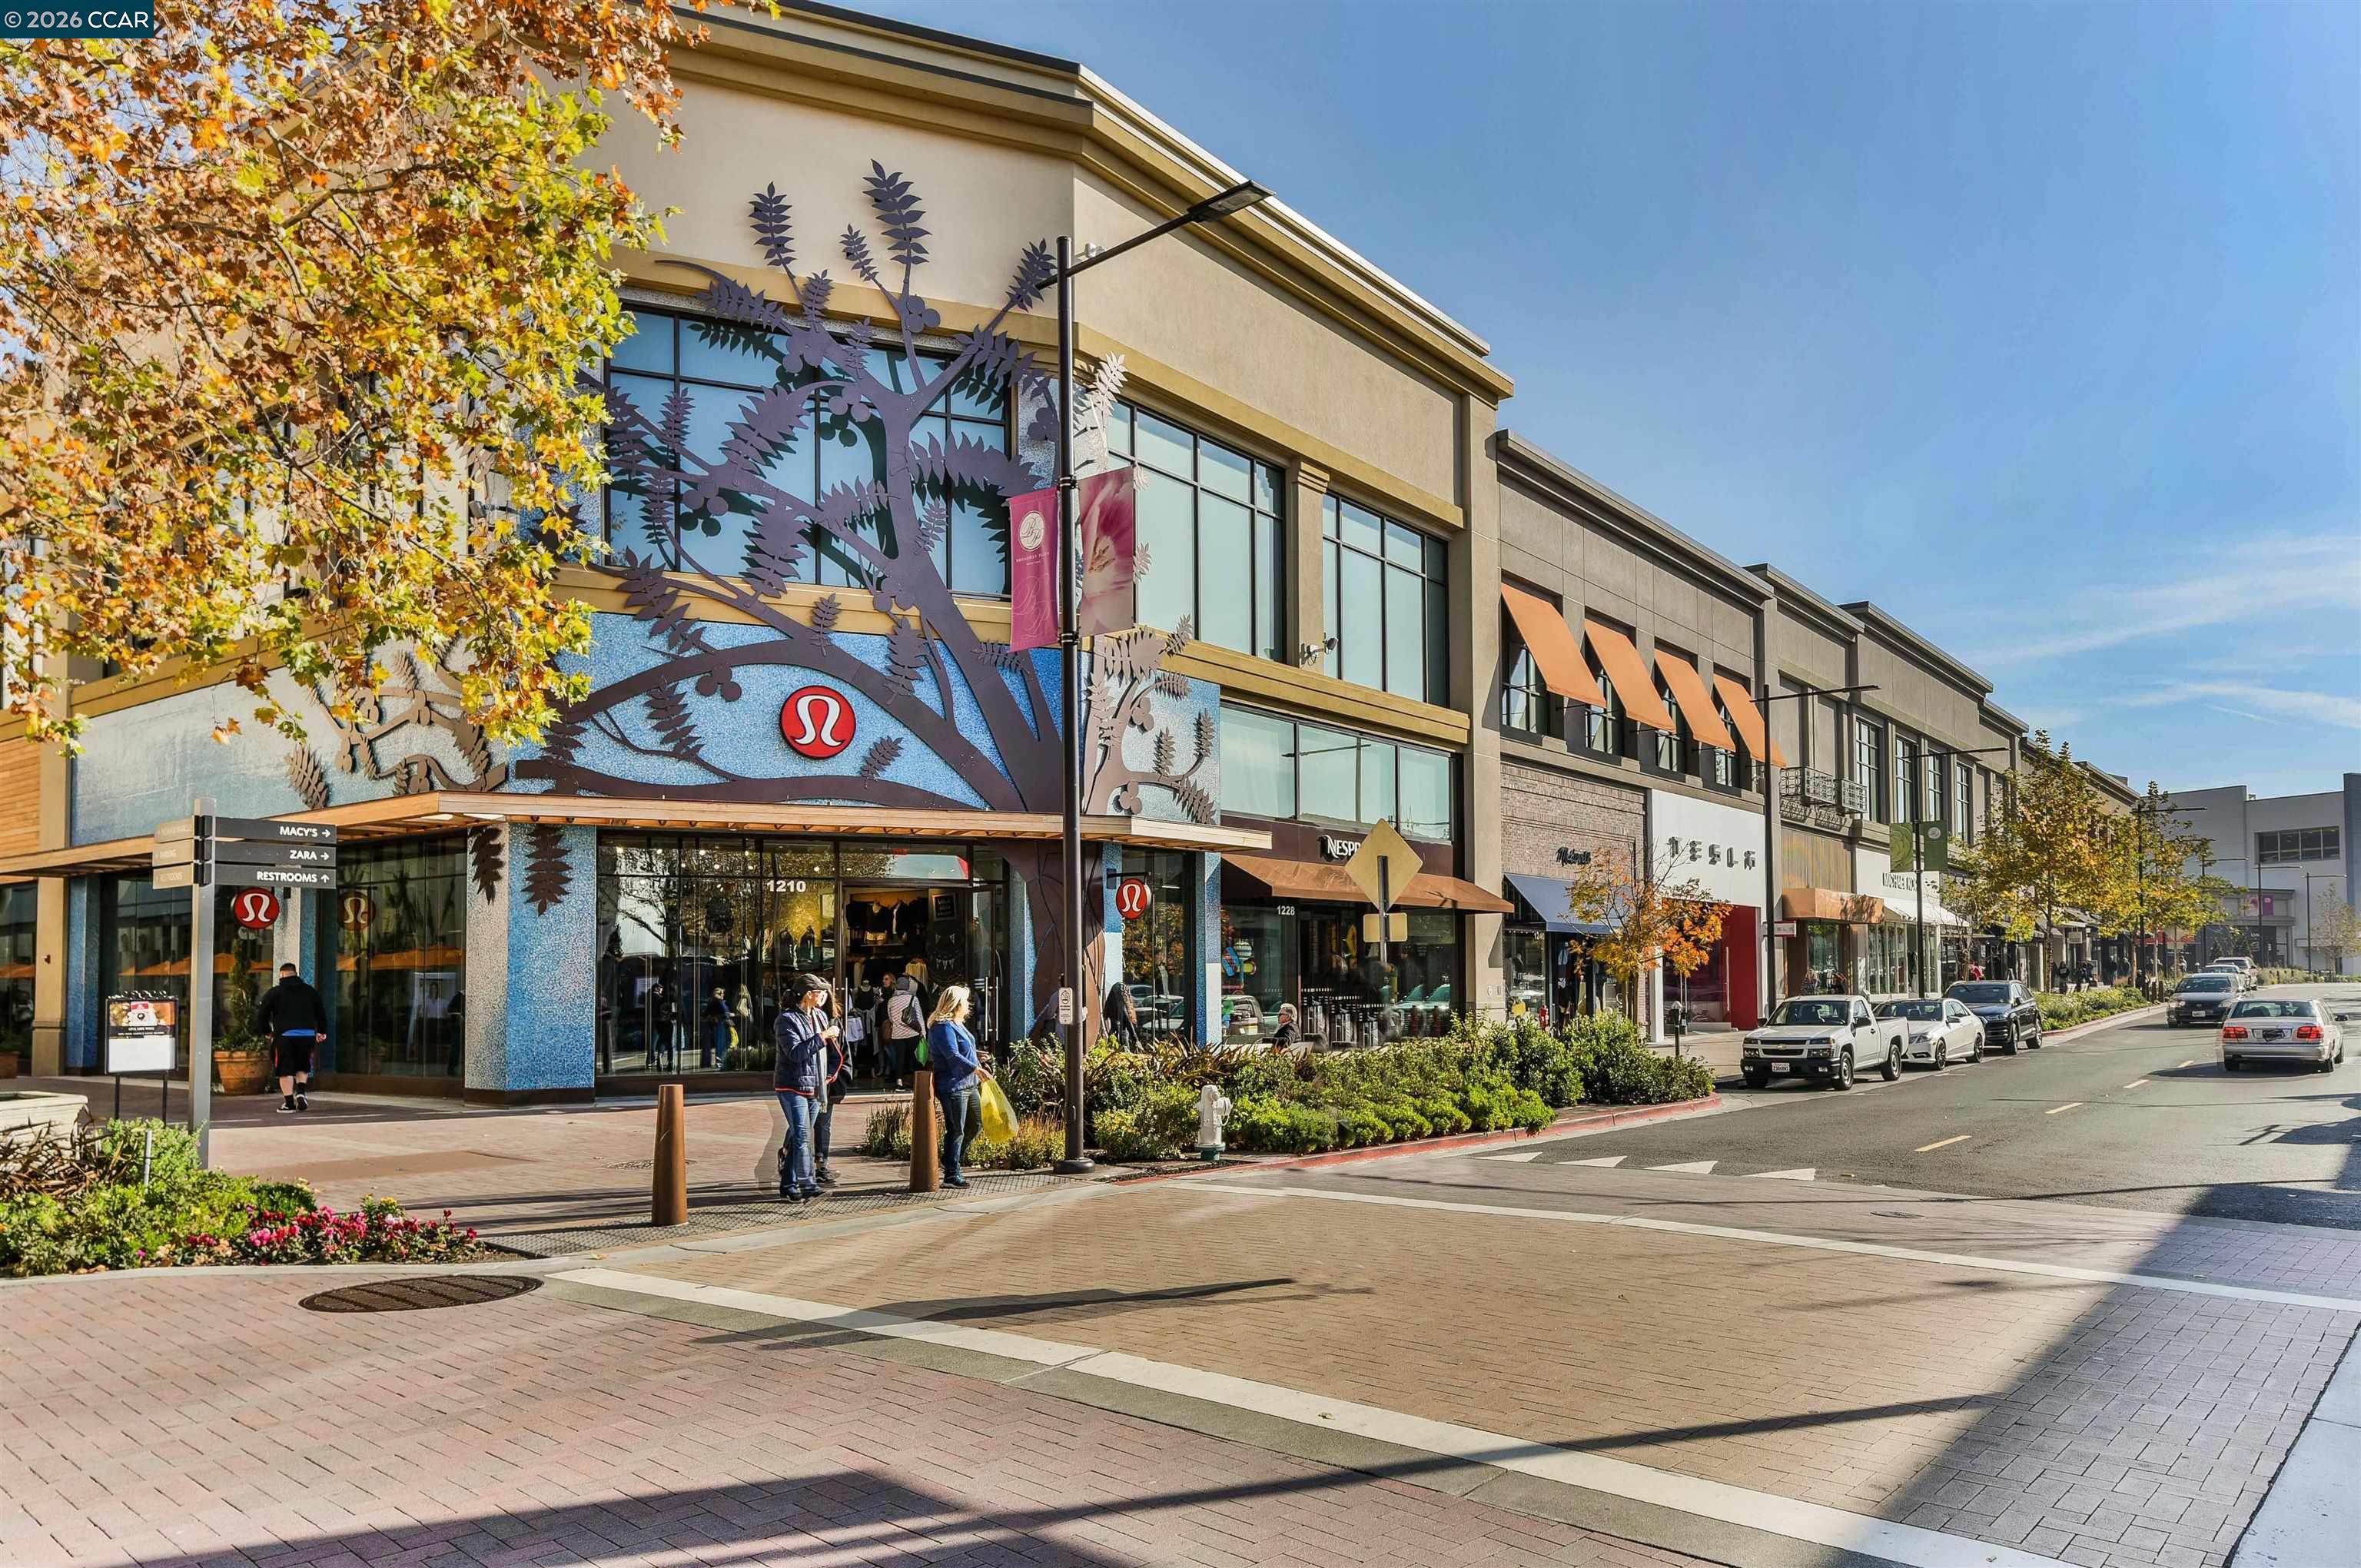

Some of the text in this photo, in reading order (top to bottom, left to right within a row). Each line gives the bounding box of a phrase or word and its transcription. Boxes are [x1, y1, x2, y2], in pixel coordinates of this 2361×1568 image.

[279, 826, 318, 838] MACY'S
[289, 849, 317, 861] ZARA
[256, 870, 318, 883] RESTROOMS
[766, 879, 806, 892] 1210
[1276, 905, 1296, 916] 1228
